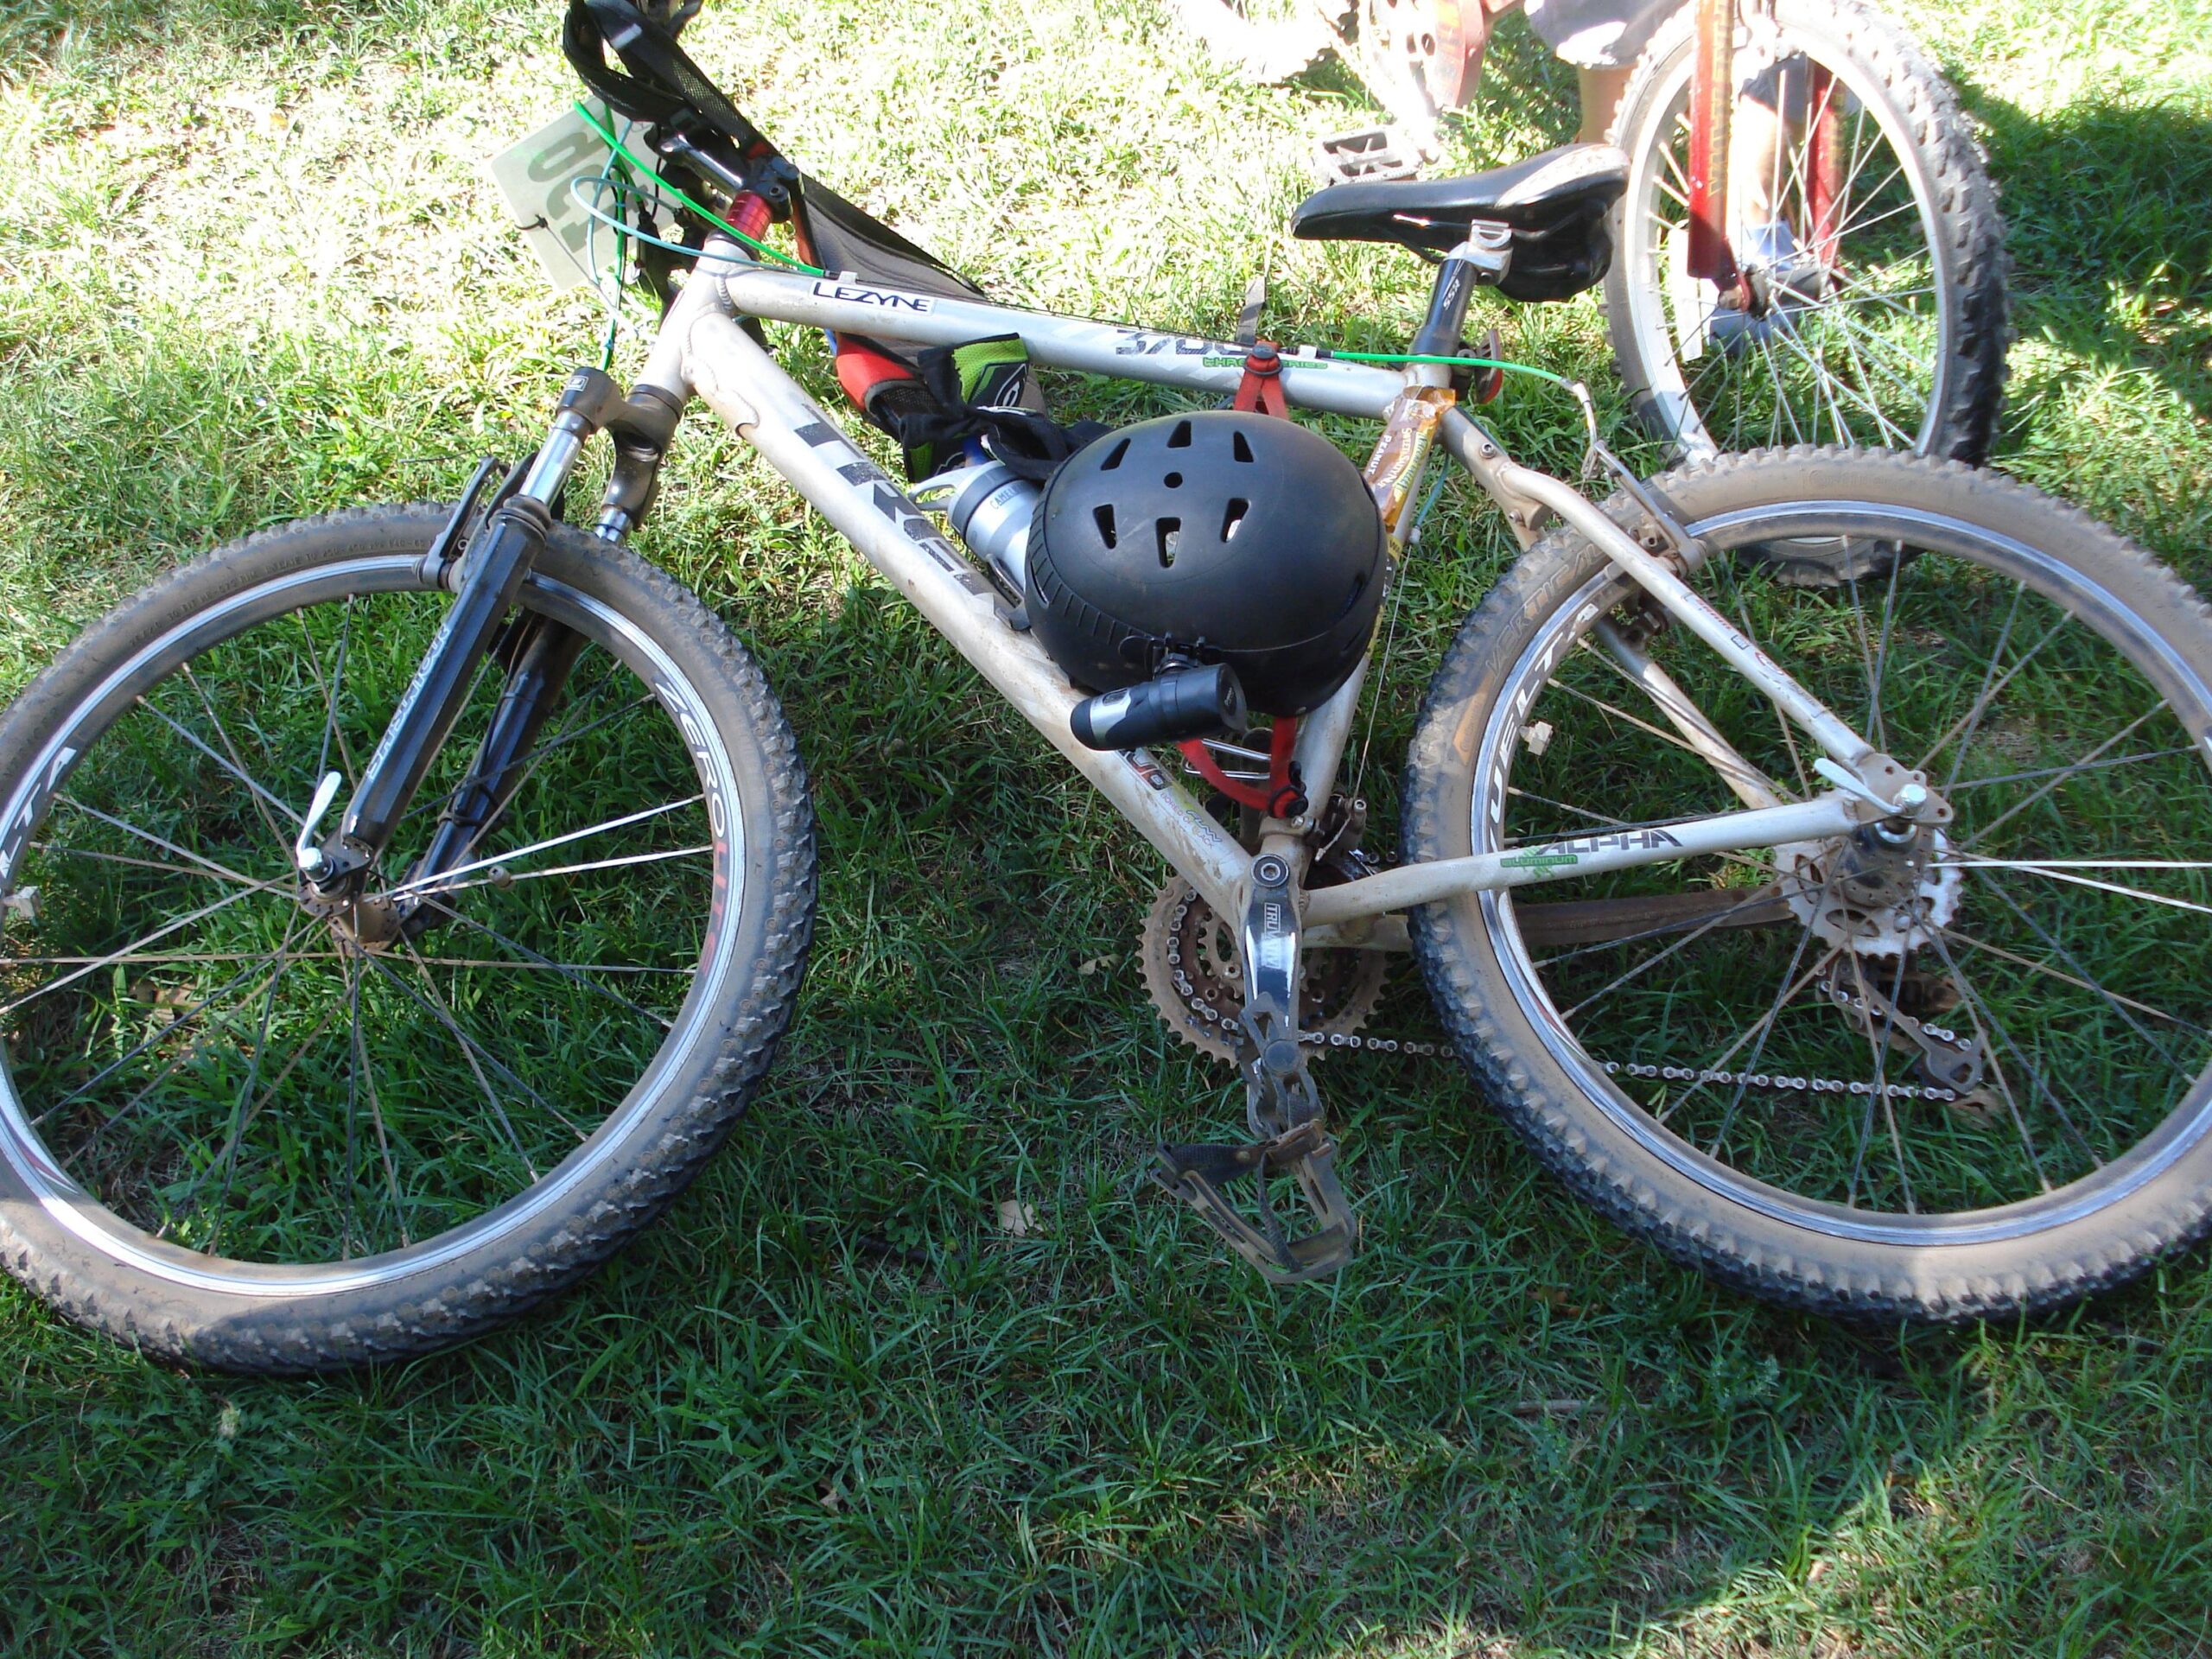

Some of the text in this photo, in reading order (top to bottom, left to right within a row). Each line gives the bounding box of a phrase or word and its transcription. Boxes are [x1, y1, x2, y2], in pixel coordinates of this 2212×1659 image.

[813, 280, 931, 313] LEZYNE
[1368, 435, 1392, 474] PEANUT
[1535, 830, 1684, 855] ALPHA
